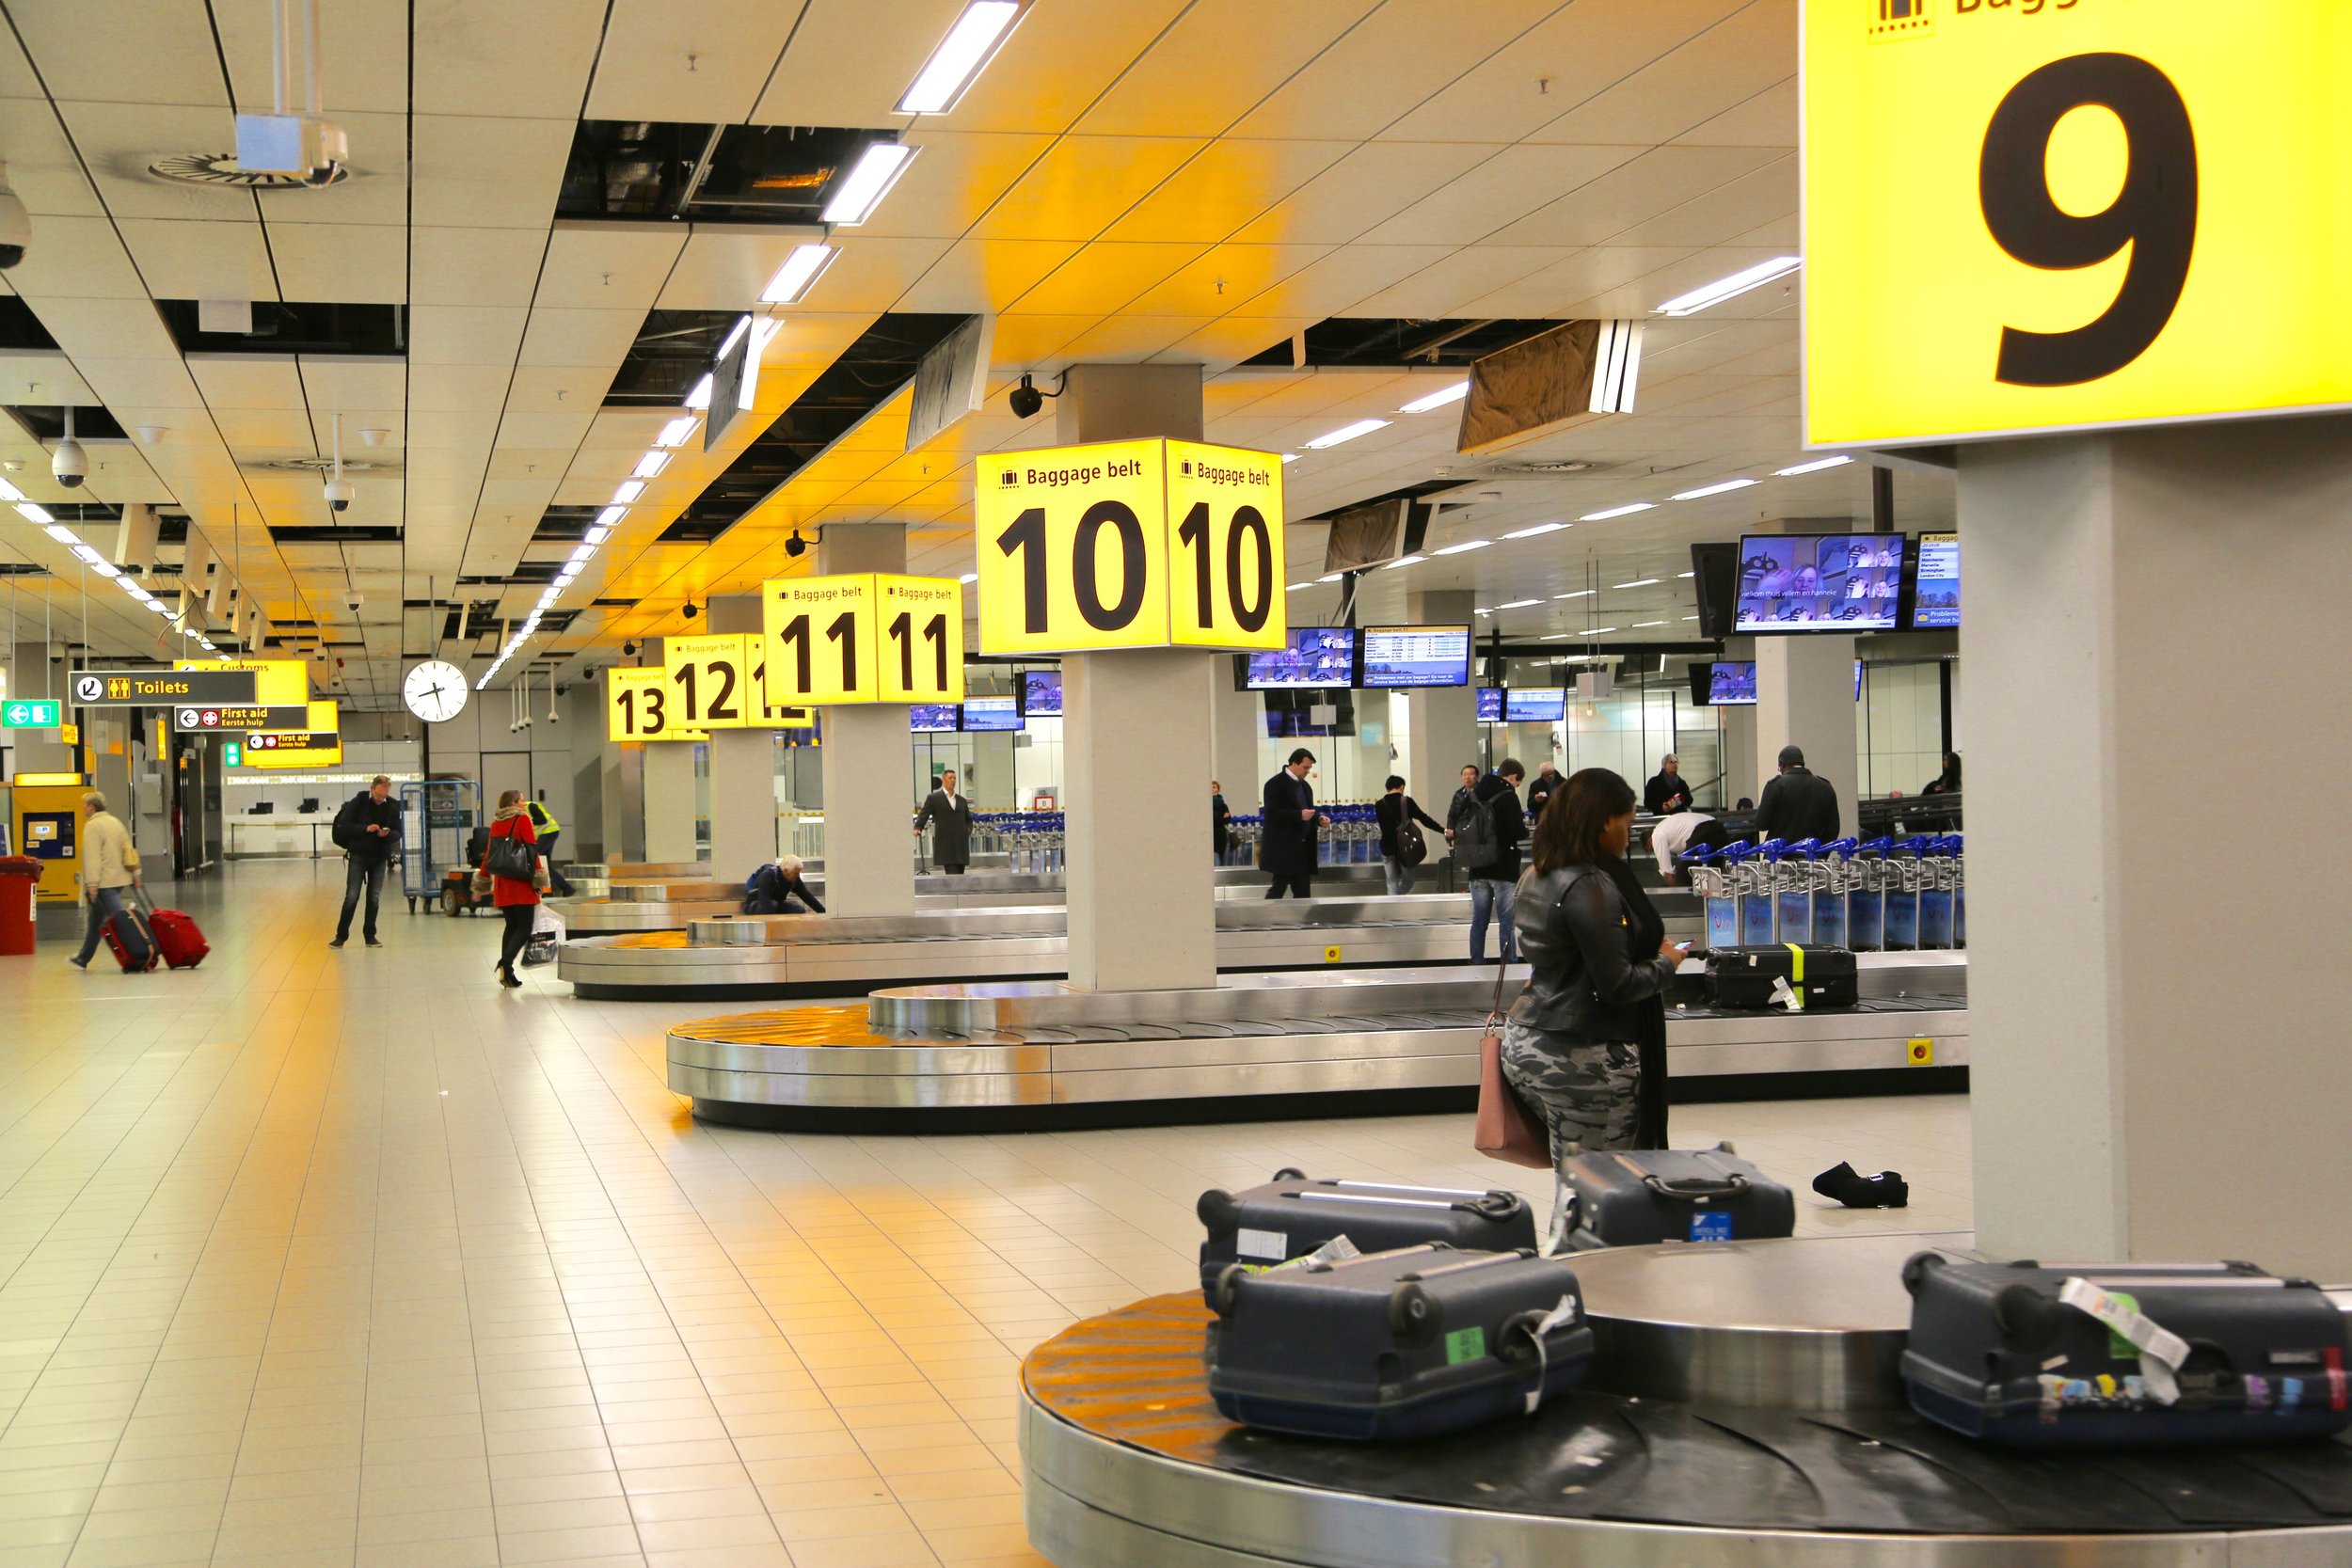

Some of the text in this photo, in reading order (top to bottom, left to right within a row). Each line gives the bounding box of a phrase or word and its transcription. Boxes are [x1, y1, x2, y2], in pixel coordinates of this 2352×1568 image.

[1979, 51, 2199, 388] 9
[1026, 459, 1142, 486] Baggage belt
[1198, 462, 1270, 486] Baggage belt
[995, 499, 1147, 634] 10
[1178, 501, 1273, 633] 10
[794, 587, 862, 602] Baggage belt
[898, 587, 952, 601] Baggage belt
[686, 644, 719, 654] Baggage
[780, 611, 857, 693] 11
[888, 611, 947, 691] 11
[220, 663, 269, 672] Customs
[135, 680, 189, 694] Toilets
[674, 660, 739, 721] 12
[221, 707, 268, 719] First aid
[246, 719, 264, 727] hulp
[616, 688, 665, 734] 13
